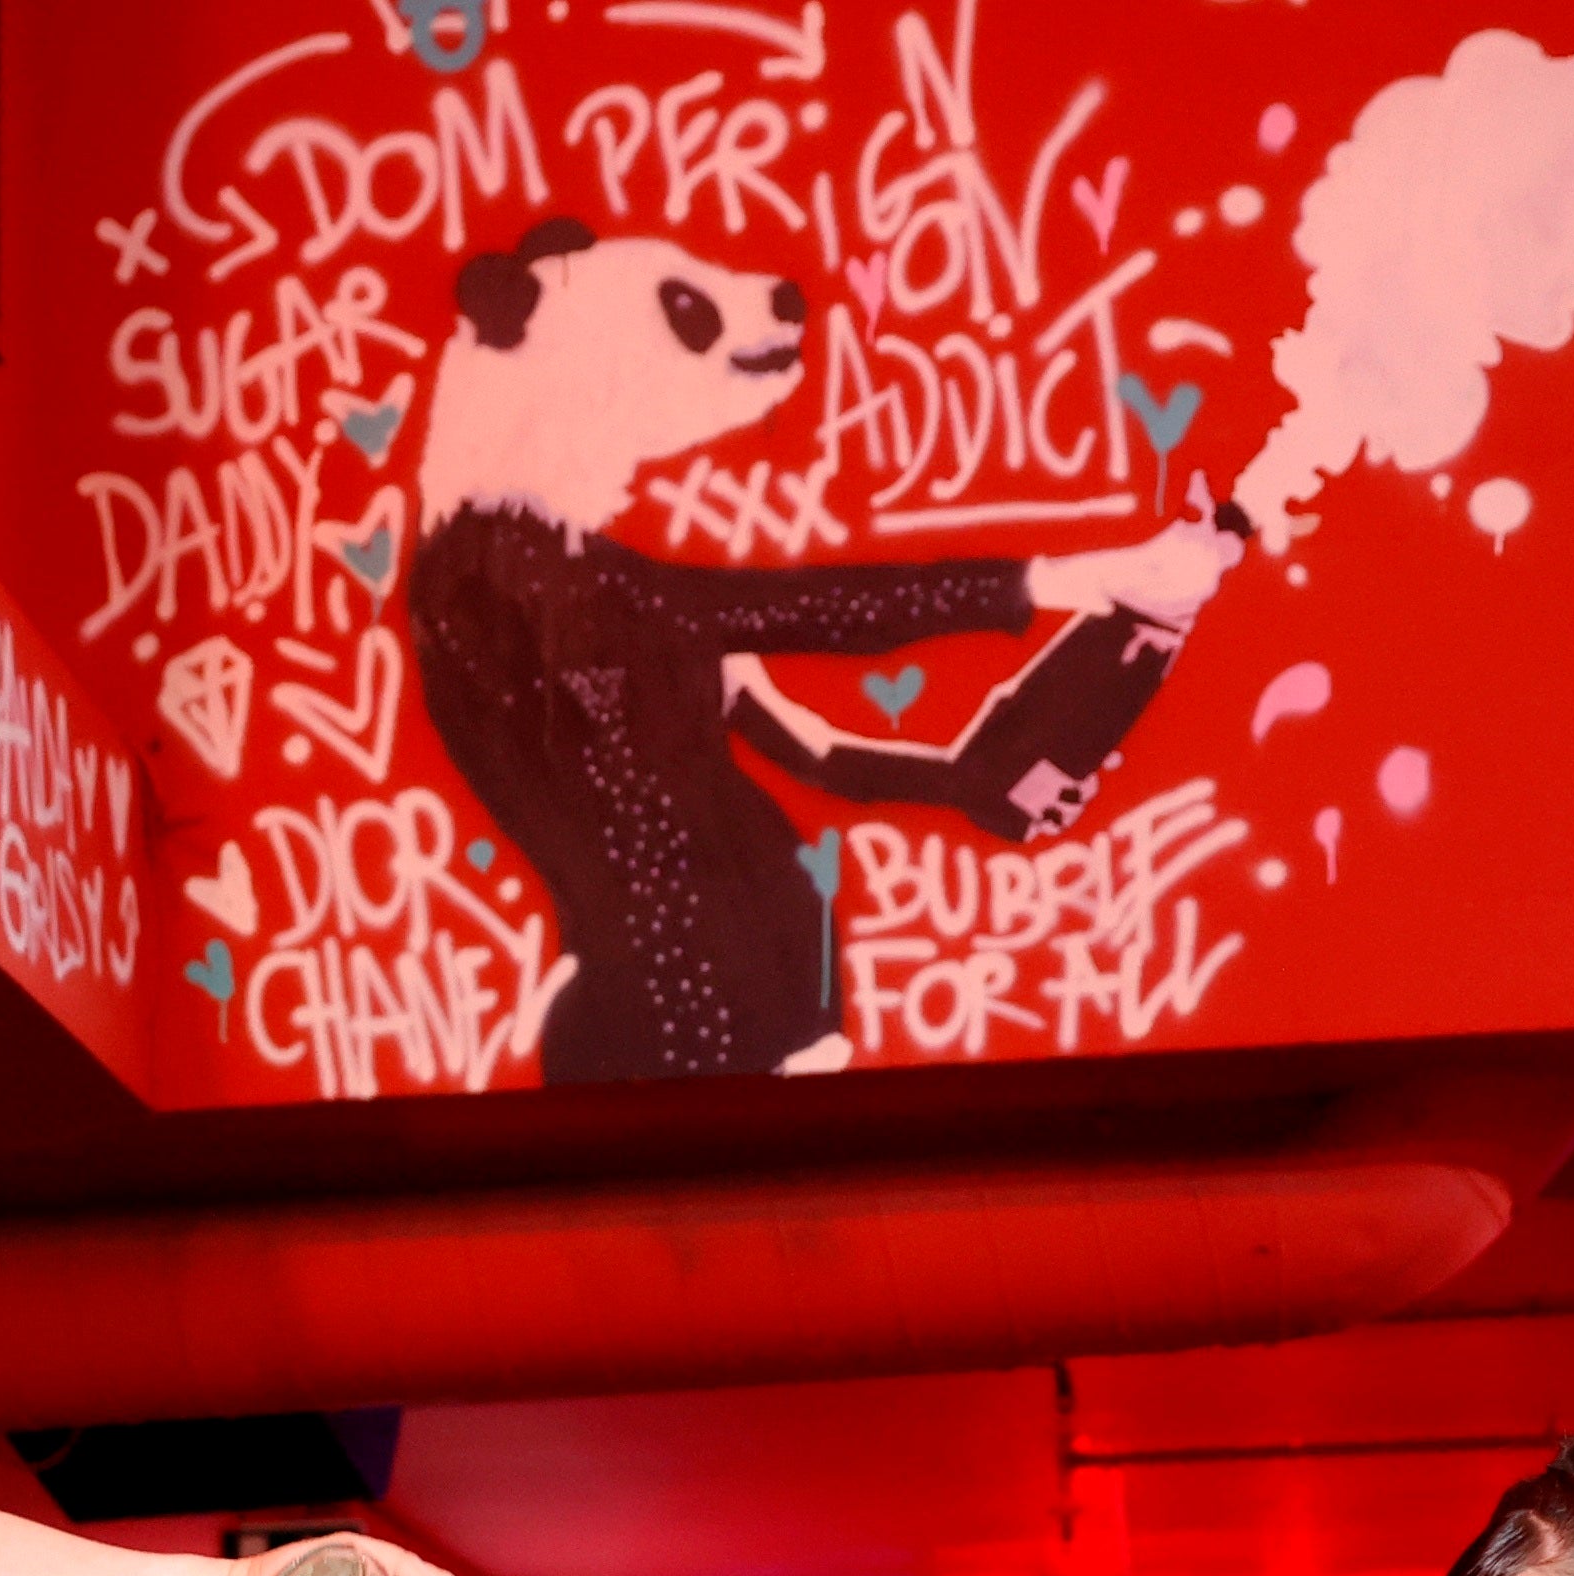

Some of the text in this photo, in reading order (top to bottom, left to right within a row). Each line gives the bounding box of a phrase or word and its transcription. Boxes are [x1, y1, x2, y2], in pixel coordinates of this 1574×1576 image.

[245, 58, 549, 264] DOM
[109, 264, 428, 443] SUGAR
[75, 434, 327, 642] DADDY
[253, 786, 528, 954] DIOR
[847, 775, 1250, 952] BUBBLE
[244, 911, 580, 1101] CHANEL
[845, 896, 1246, 1057] FOR ALL
